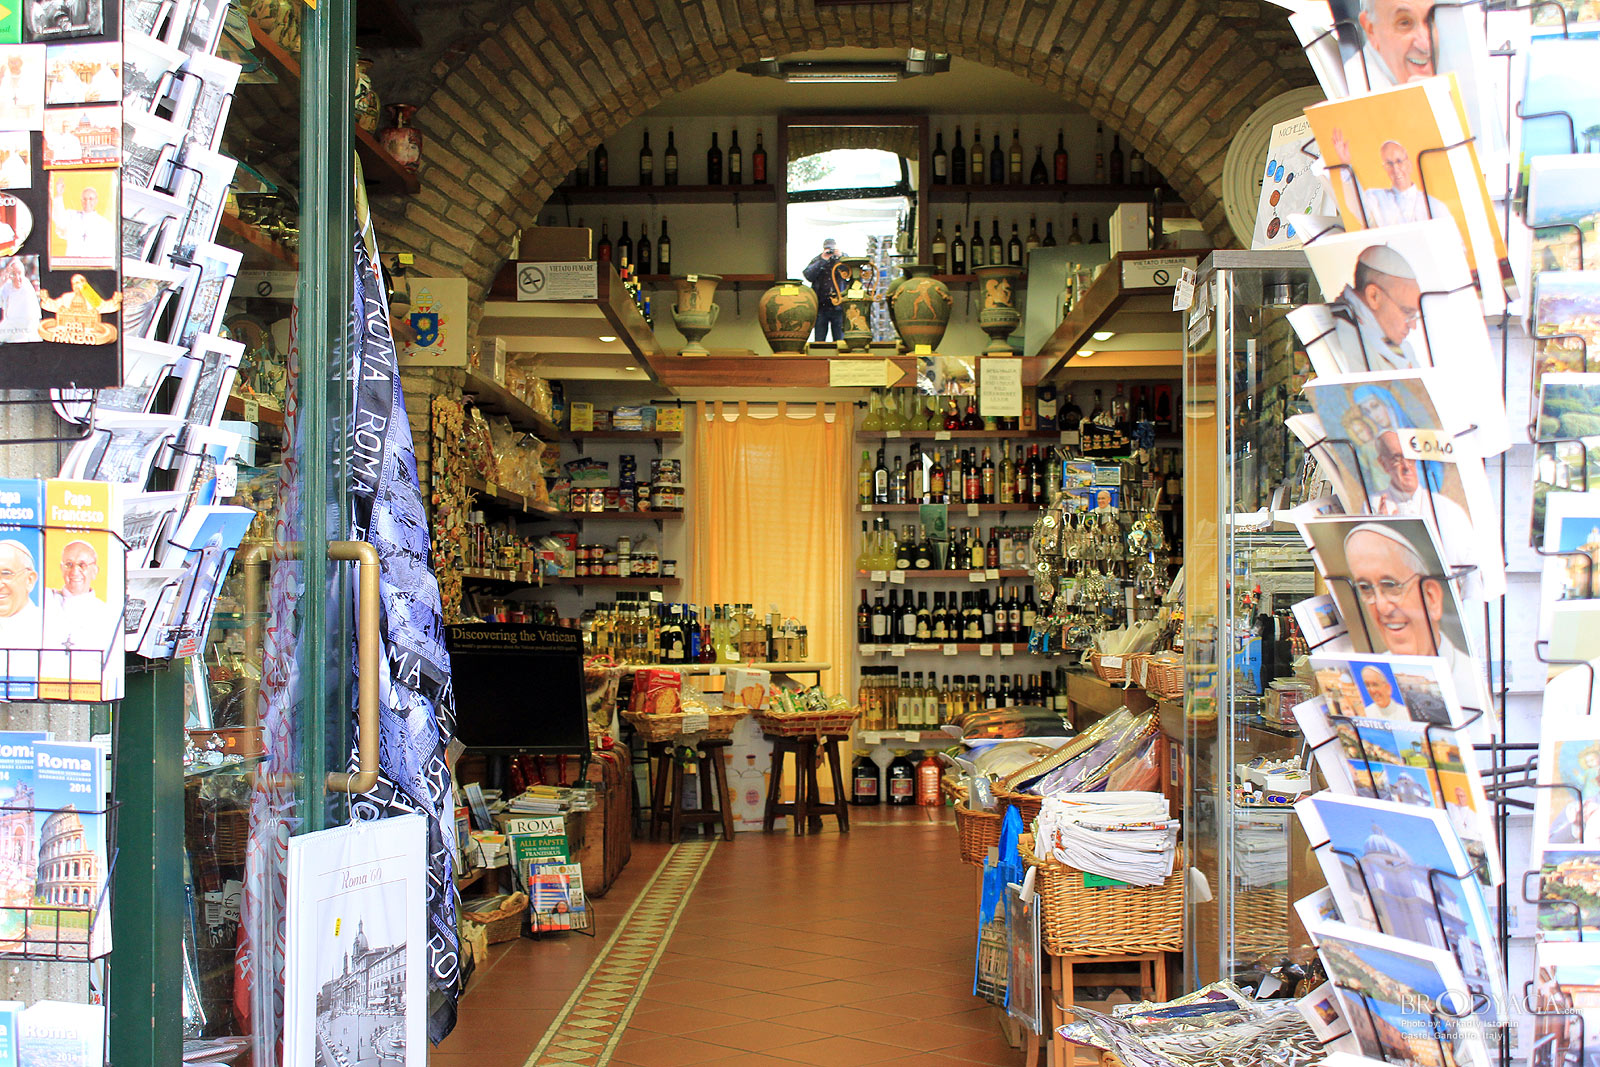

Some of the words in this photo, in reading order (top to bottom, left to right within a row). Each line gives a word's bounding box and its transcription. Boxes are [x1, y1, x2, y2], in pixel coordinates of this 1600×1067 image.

[363, 297, 393, 381] ROMA
[353, 408, 387, 494] ROMA
[64, 490, 91, 509] Papa
[52, 505, 104, 523] Francesco
[452, 627, 518, 644] Discovering
[519, 629, 536, 641] the
[538, 630, 577, 643] Vatican
[37, 752, 92, 771] Roma
[69, 783, 92, 793] 2014
[517, 820, 555, 833] ROM
[551, 865, 577, 874] ROM
[341, 869, 368, 890] Roma
[24, 1024, 79, 1041] Roma
